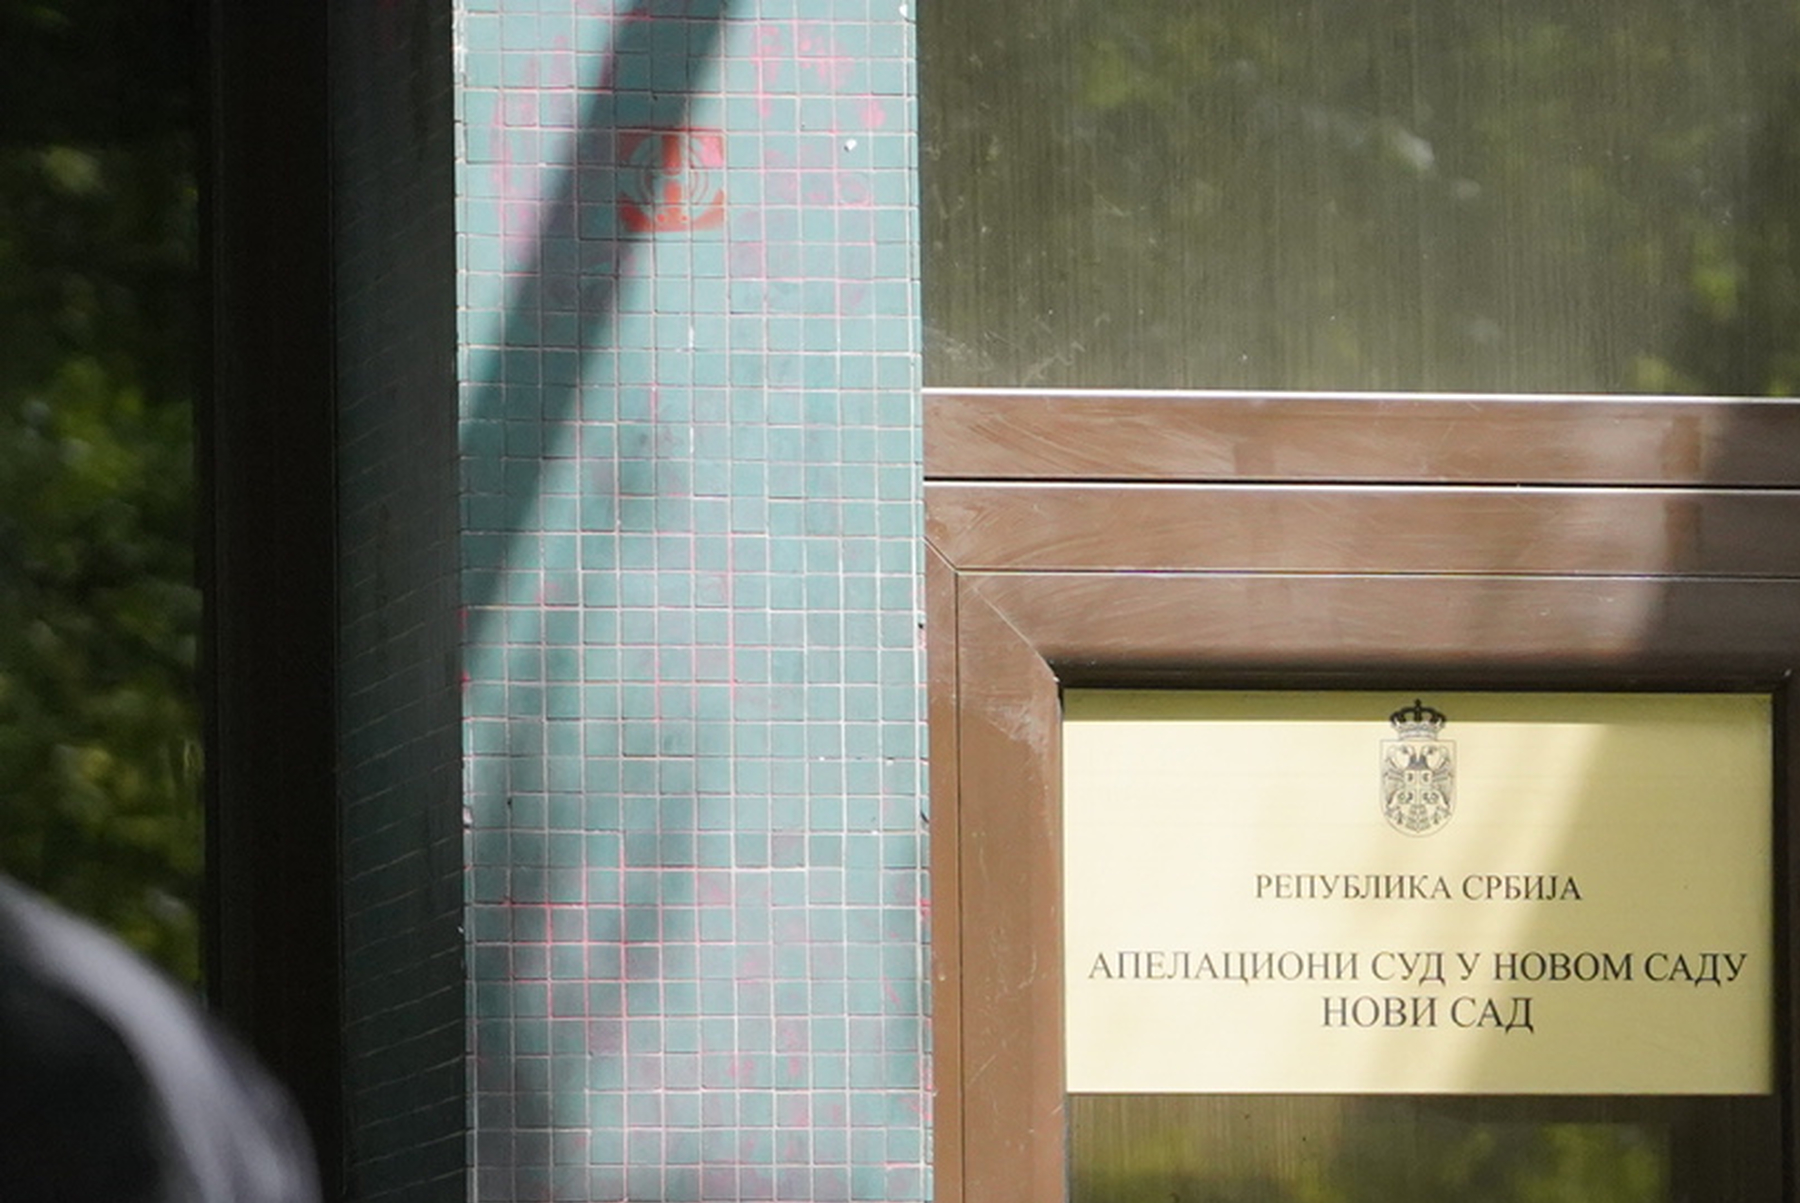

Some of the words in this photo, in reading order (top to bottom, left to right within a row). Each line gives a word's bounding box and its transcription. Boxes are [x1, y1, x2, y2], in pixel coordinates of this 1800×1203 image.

[1255, 873, 1453, 901] РЕПУБЛИКА
[1461, 873, 1583, 902] СРБИЈА
[1087, 950, 1360, 986] АПЕЛАЦИОНИ
[1370, 950, 1447, 988] СУД
[1455, 951, 1482, 982] У
[1492, 950, 1635, 983] НОВОМ
[1643, 951, 1748, 988] САДУ
[1321, 995, 1440, 1028] НОВИ
[1449, 995, 1535, 1034] САД
